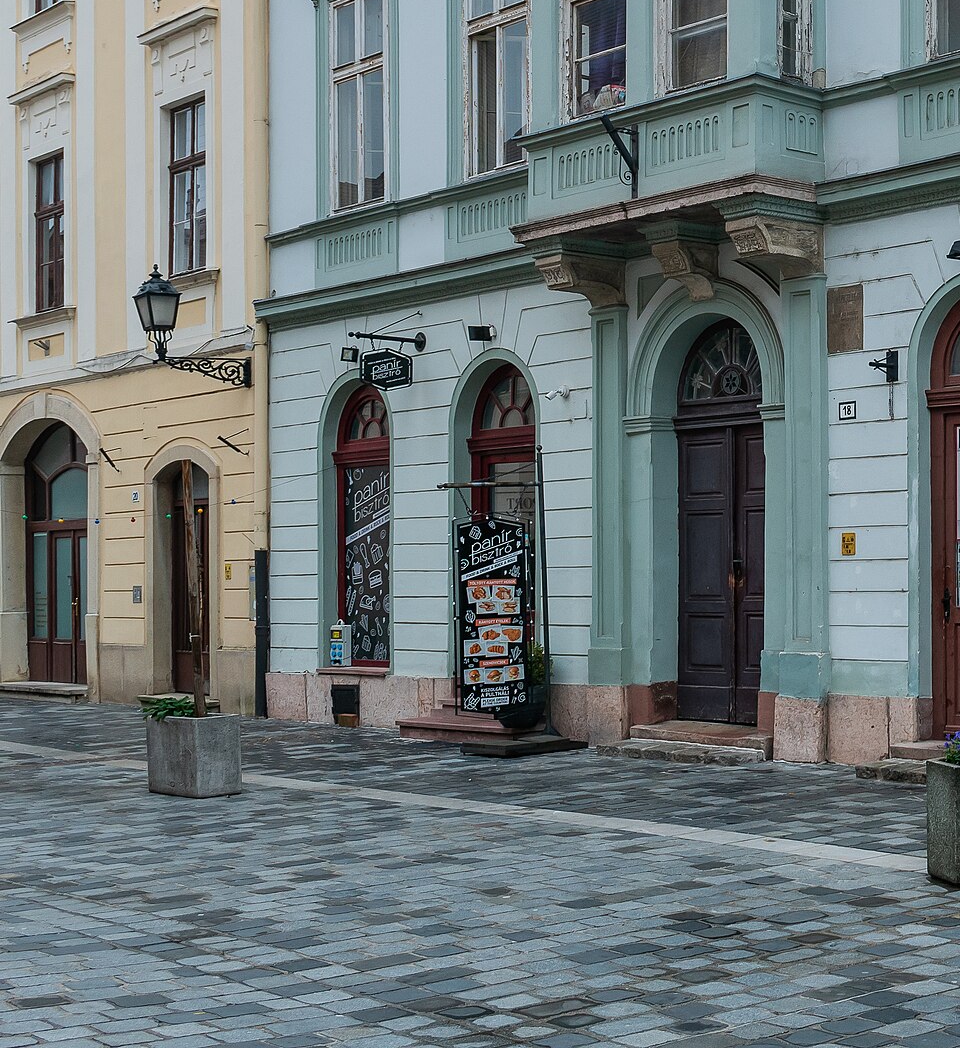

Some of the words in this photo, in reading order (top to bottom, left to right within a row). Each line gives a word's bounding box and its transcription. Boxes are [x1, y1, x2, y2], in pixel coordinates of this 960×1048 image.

[842, 405, 852, 416] 18
[354, 472, 390, 505] panír
[472, 529, 512, 552] panír
[472, 543, 512, 565] bisztró
